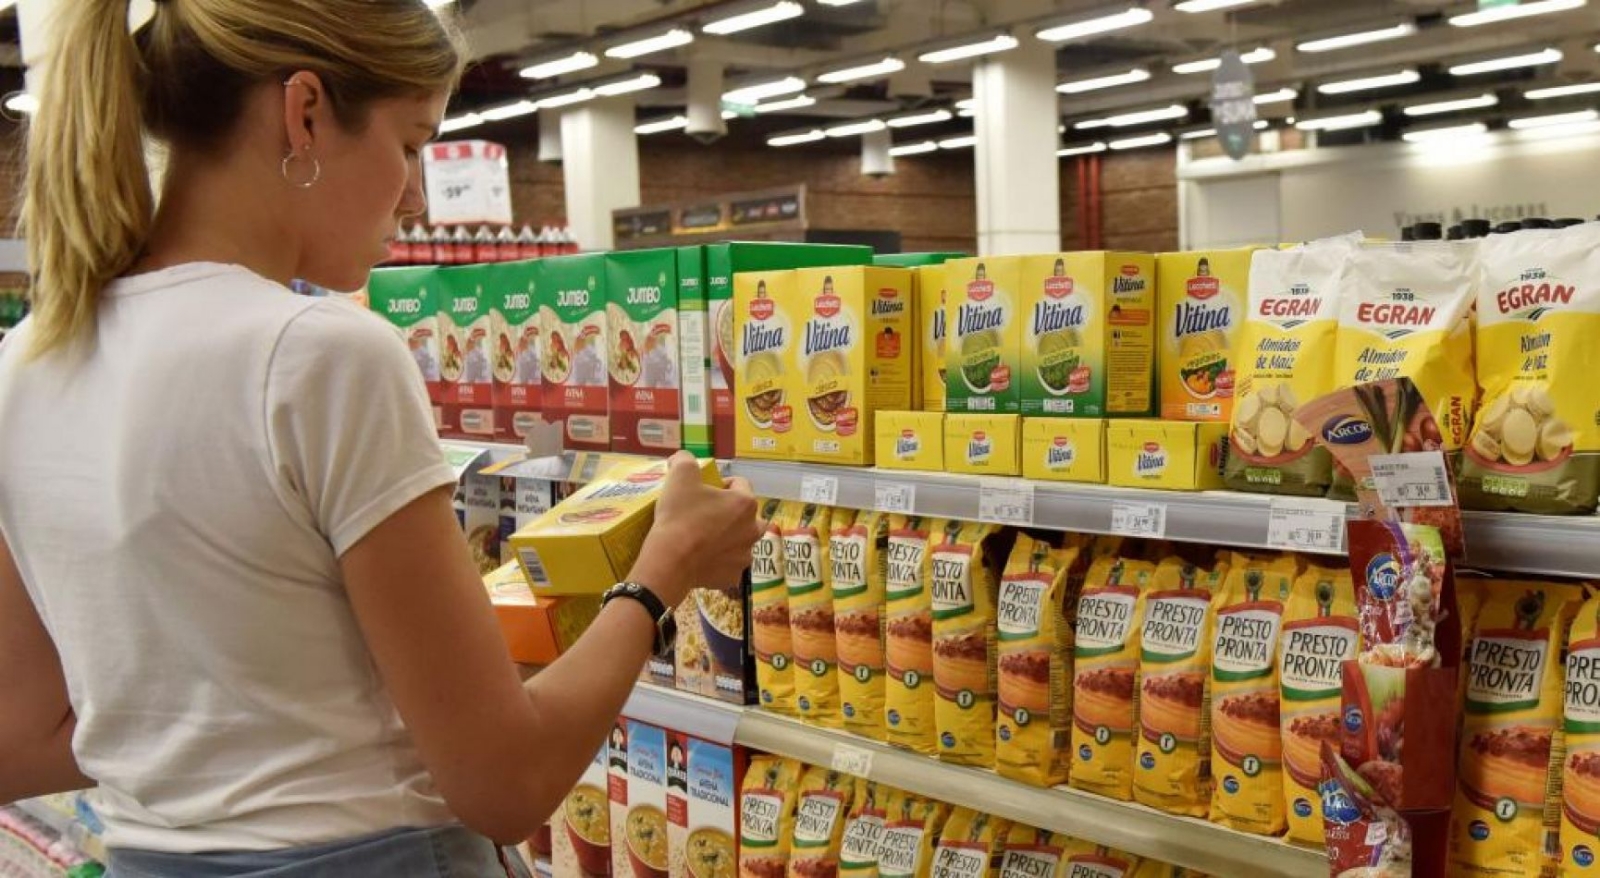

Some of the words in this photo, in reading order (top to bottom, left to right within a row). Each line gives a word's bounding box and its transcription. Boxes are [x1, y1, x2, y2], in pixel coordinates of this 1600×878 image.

[628, 286, 661, 304] JUMBO
[1113, 276, 1145, 294] Vitina
[387, 298, 421, 313] JUMBO
[453, 298, 478, 313] JUMBO
[503, 294, 530, 309] JUMBO
[557, 290, 590, 307] JUMBO
[872, 299, 904, 315] Vitina
[1259, 297, 1322, 317] EGRAN
[1392, 292, 1416, 302] 1938
[1497, 282, 1576, 314] EGRAN
[958, 304, 1002, 337] Vitina
[1034, 302, 1083, 335] Vitina
[1175, 303, 1230, 338] Vitina
[1357, 303, 1436, 326] EGRAN
[743, 321, 784, 357] Vitina
[805, 319, 850, 355] Vitina
[1255, 355, 1268, 370] de
[1354, 366, 1372, 382] de
[1451, 396, 1461, 445] EGRAN
[1049, 446, 1072, 464] Vitina
[1138, 453, 1164, 471] Vitina
[752, 540, 774, 556] STO
[889, 542, 922, 564] RESTO
[785, 560, 817, 579] ONTA
[1004, 583, 1039, 606] PRESTO
[1000, 601, 1037, 626] PRONTA
[1079, 598, 1129, 622] PRESTO
[1152, 601, 1205, 626] PRESTO
[1075, 617, 1124, 640] PRONTA
[1144, 621, 1198, 646] PRONTA
[1221, 616, 1272, 641] PRESTO
[1216, 637, 1267, 663] PRONTA
[1290, 631, 1348, 658] PRESTO
[1284, 653, 1343, 681] PRONTA
[1474, 641, 1541, 672] PRESTO
[1568, 655, 1600, 681] PRE
[1470, 663, 1534, 693] PRONTA
[1565, 681, 1600, 707] PRO
[745, 797, 778, 820] PRESTO
[884, 830, 918, 853] PRESTO
[880, 847, 915, 867] PRONTA
[939, 848, 982, 874] PRESTO
